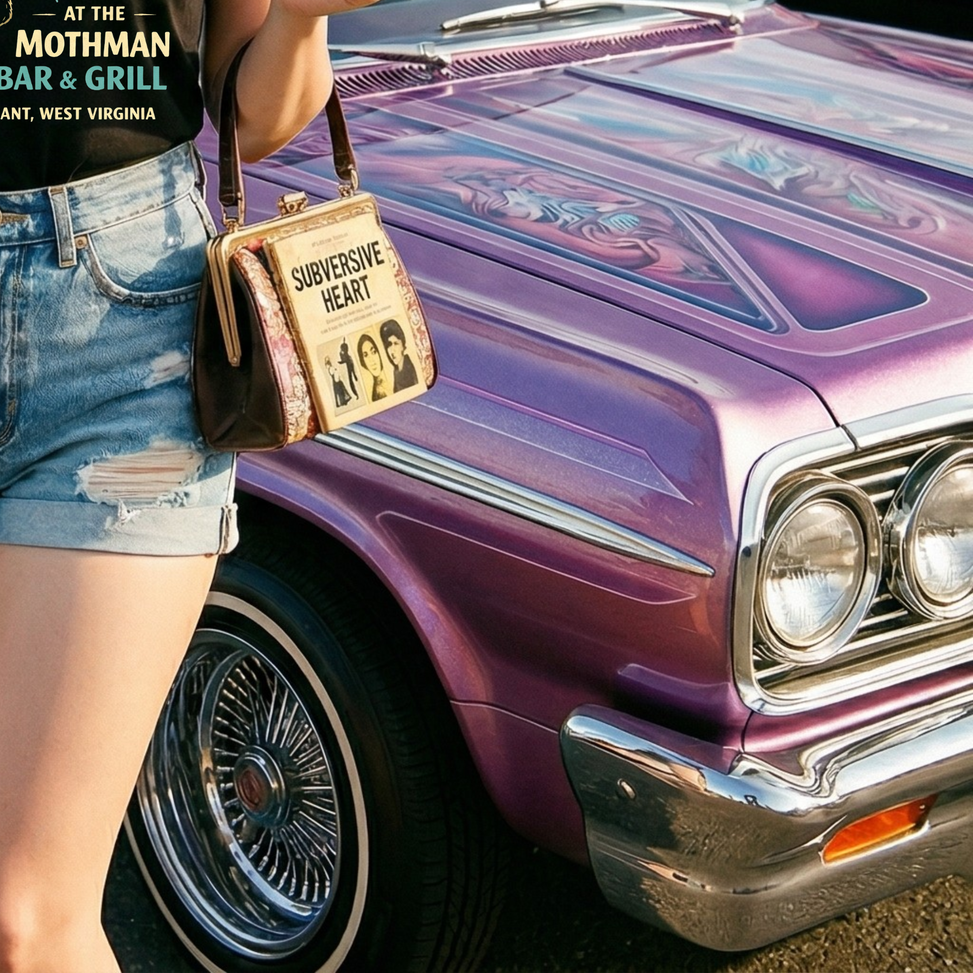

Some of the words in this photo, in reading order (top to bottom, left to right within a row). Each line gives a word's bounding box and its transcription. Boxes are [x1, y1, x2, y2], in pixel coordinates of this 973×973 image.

[63, 5, 86, 21] AT
[90, 5, 126, 21] THE
[15, 29, 171, 58] MOTHMAN
[59, 70, 78, 90] &
[84, 65, 168, 91] GRILL
[39, 106, 83, 121] WEST
[87, 106, 156, 121] VIRGINIA
[291, 240, 385, 292] SUBVERSIVE
[320, 274, 371, 314] HEART
